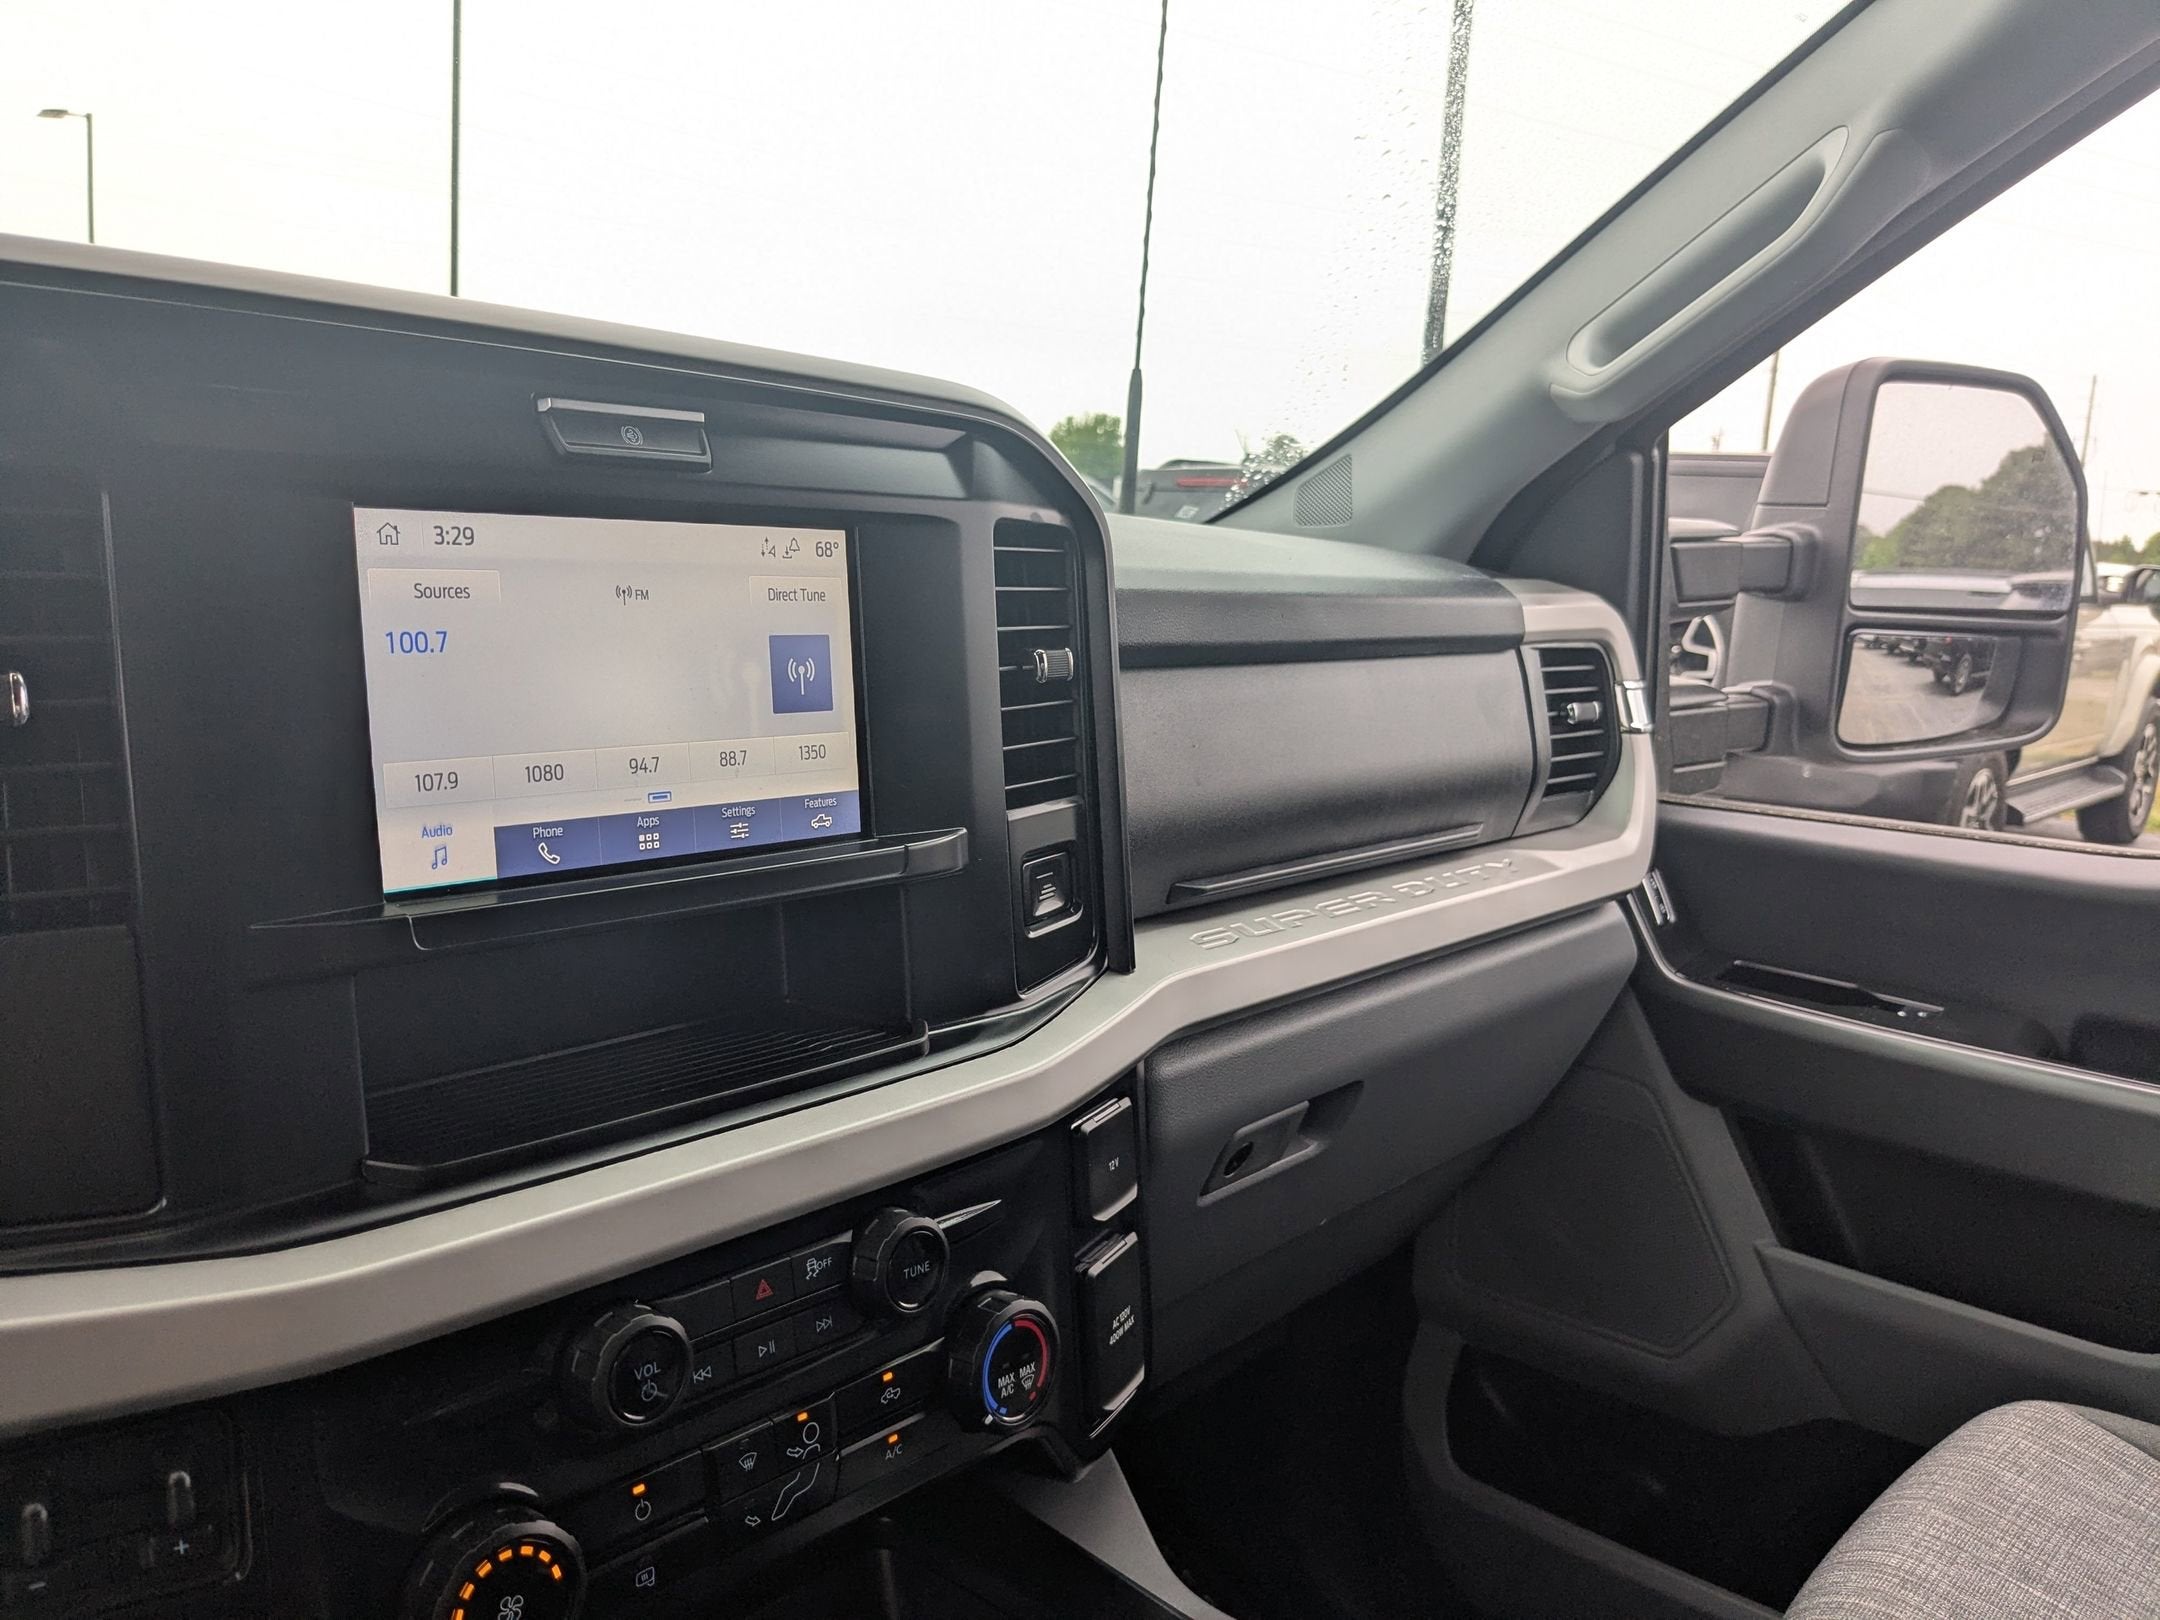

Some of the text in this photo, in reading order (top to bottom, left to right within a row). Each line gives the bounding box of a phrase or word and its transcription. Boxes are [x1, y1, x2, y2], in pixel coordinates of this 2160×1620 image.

[433, 525, 475, 546] 3:29
[815, 541, 839, 558] 68°
[413, 583, 471, 599] Sources
[635, 589, 650, 601] FM
[768, 587, 826, 602] Direct Tune
[385, 631, 448, 654] 100.7
[719, 750, 747, 767] 88.7
[798, 743, 826, 761] 1350
[525, 763, 564, 783] 1080
[629, 756, 660, 775] 94.7
[414, 771, 459, 793] 107.9
[804, 796, 837, 809] Features
[721, 804, 756, 819] Settings
[637, 814, 660, 828] Apps
[421, 823, 453, 839] Audio
[533, 825, 563, 839] Phone
[1189, 858, 1519, 951] SUPER DUTY
[816, 1256, 833, 1270] OFF
[903, 1260, 931, 1279] TUNE
[633, 1361, 661, 1380] VOL
[1019, 1361, 1036, 1378] MAX
[998, 1371, 1016, 1389] MAX
[1001, 1383, 1015, 1399] A/C
[885, 1443, 903, 1460] A/C
